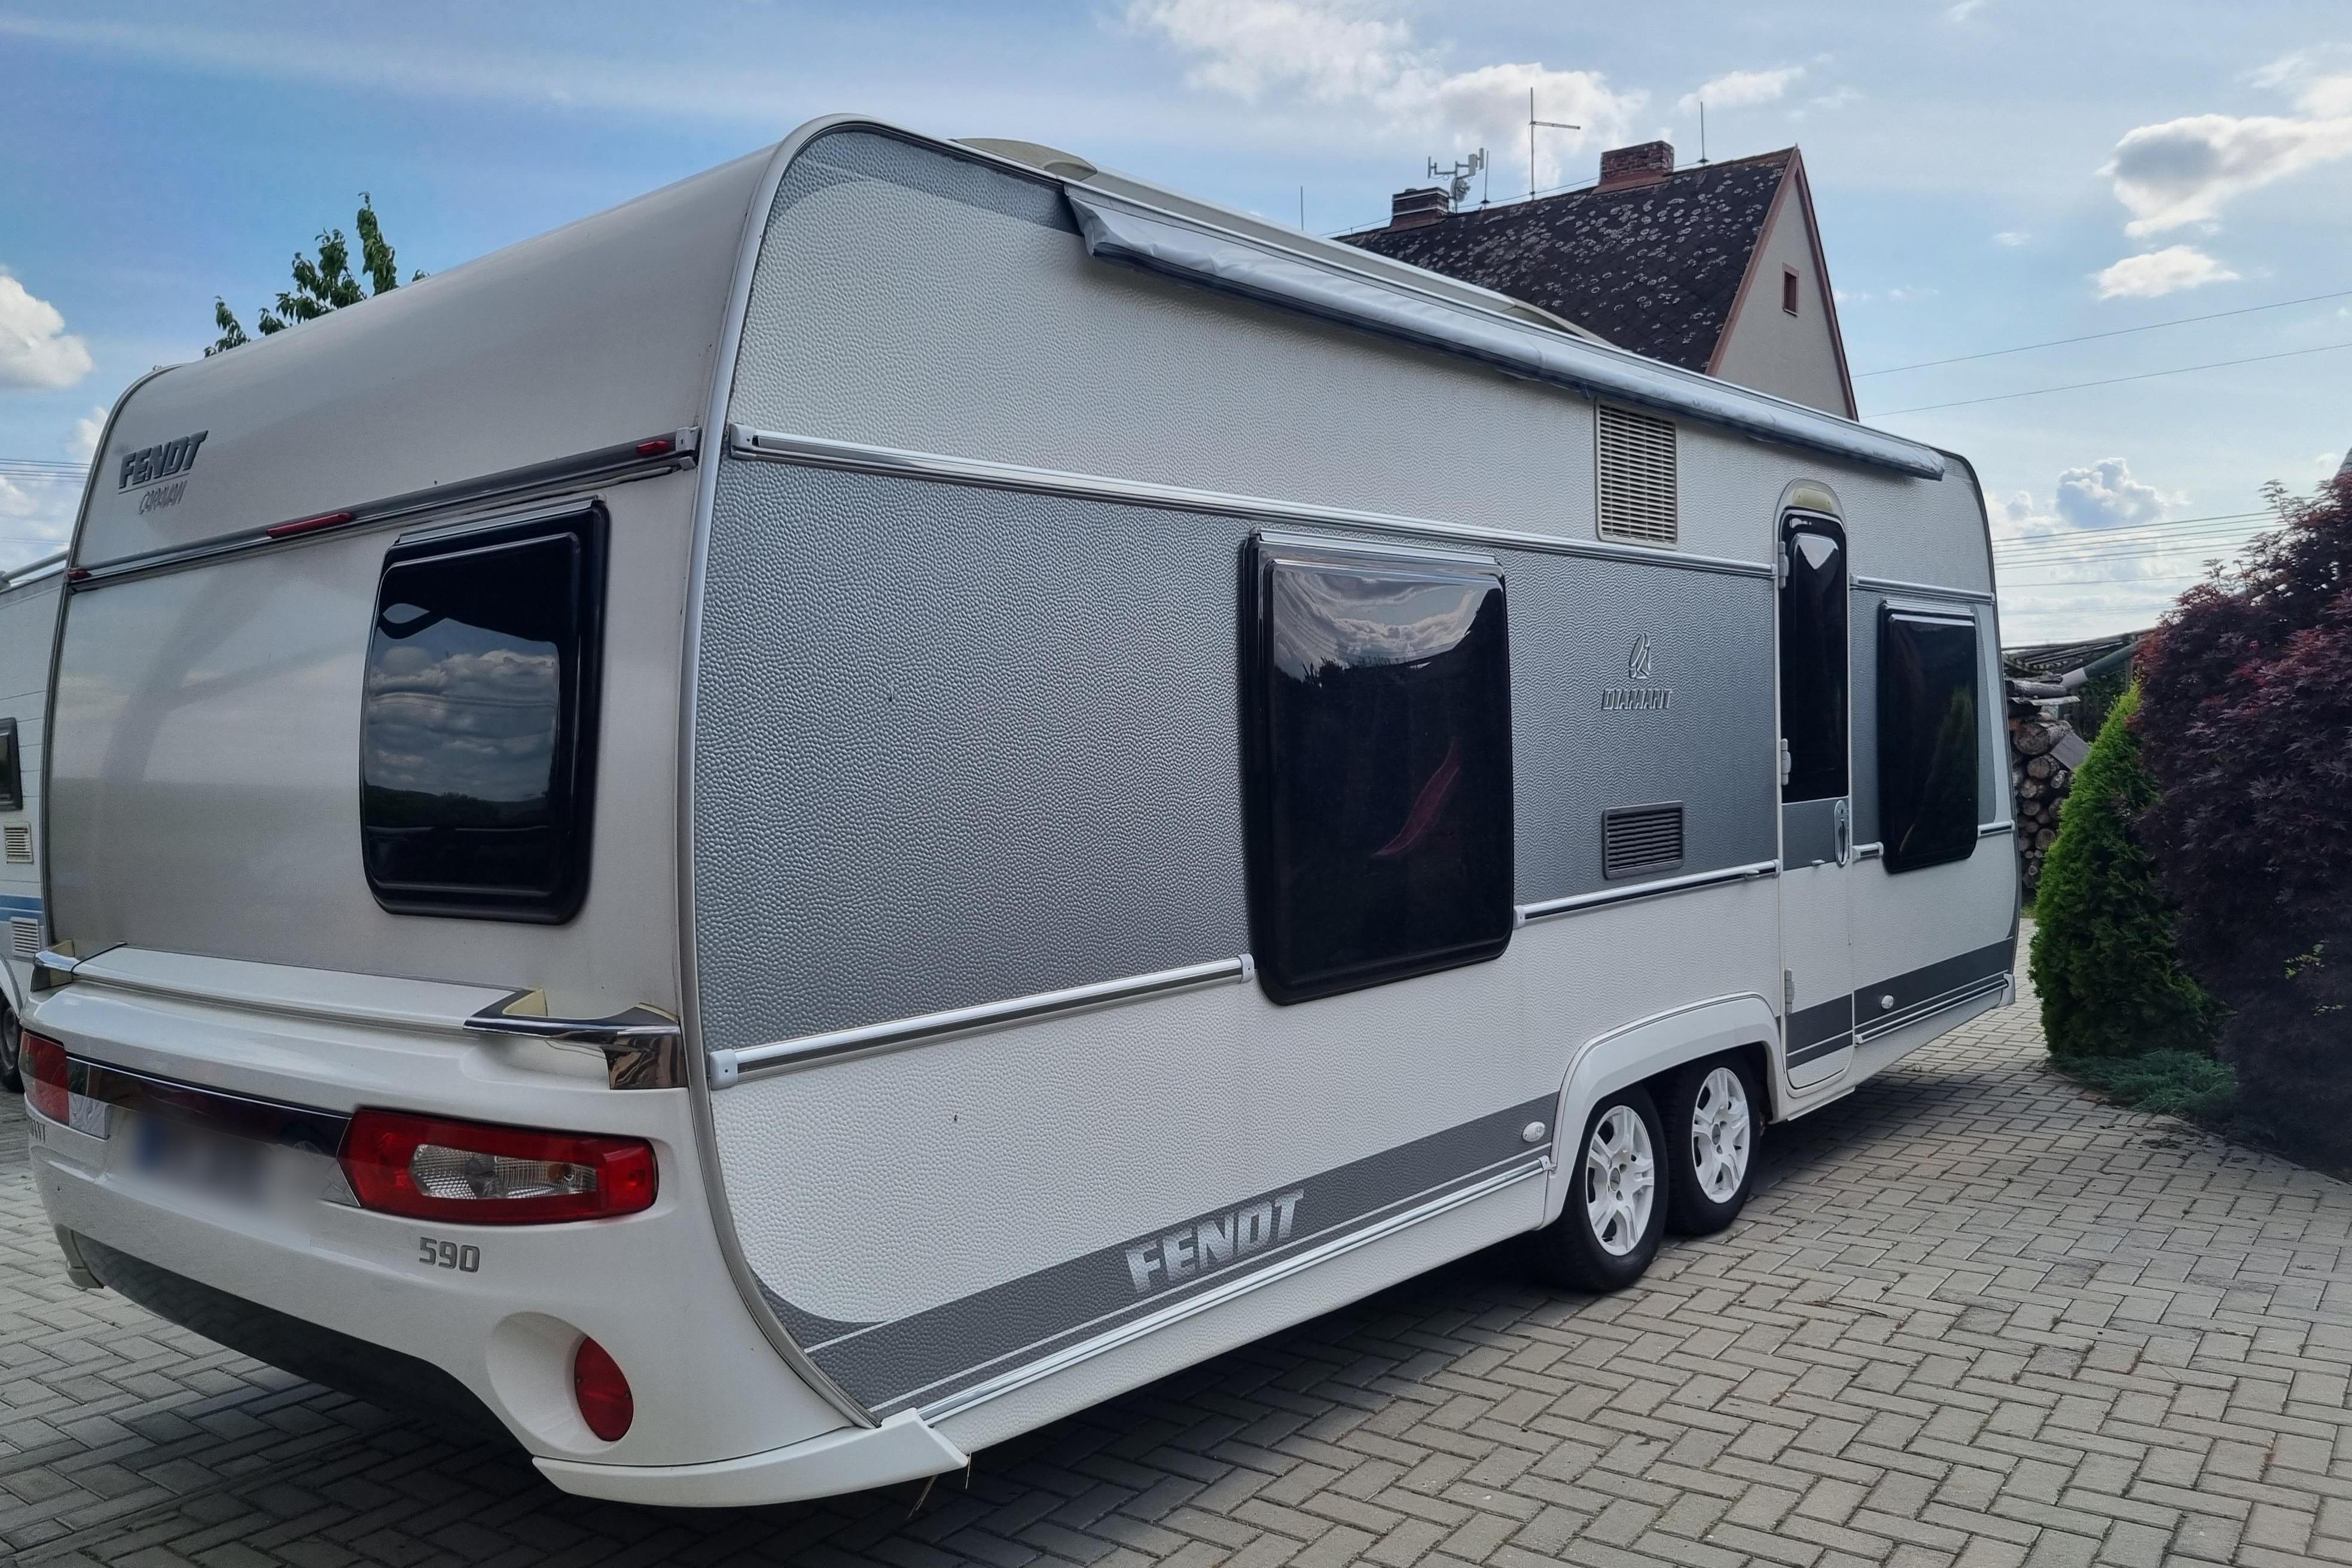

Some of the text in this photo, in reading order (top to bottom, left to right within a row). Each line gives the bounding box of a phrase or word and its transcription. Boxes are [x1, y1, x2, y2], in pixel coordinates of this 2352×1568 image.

[119, 430, 208, 489] FENDT
[1602, 688, 1672, 710] DIAMANT
[419, 1237, 480, 1273] 590
[1125, 1189, 1304, 1294] FENDT
